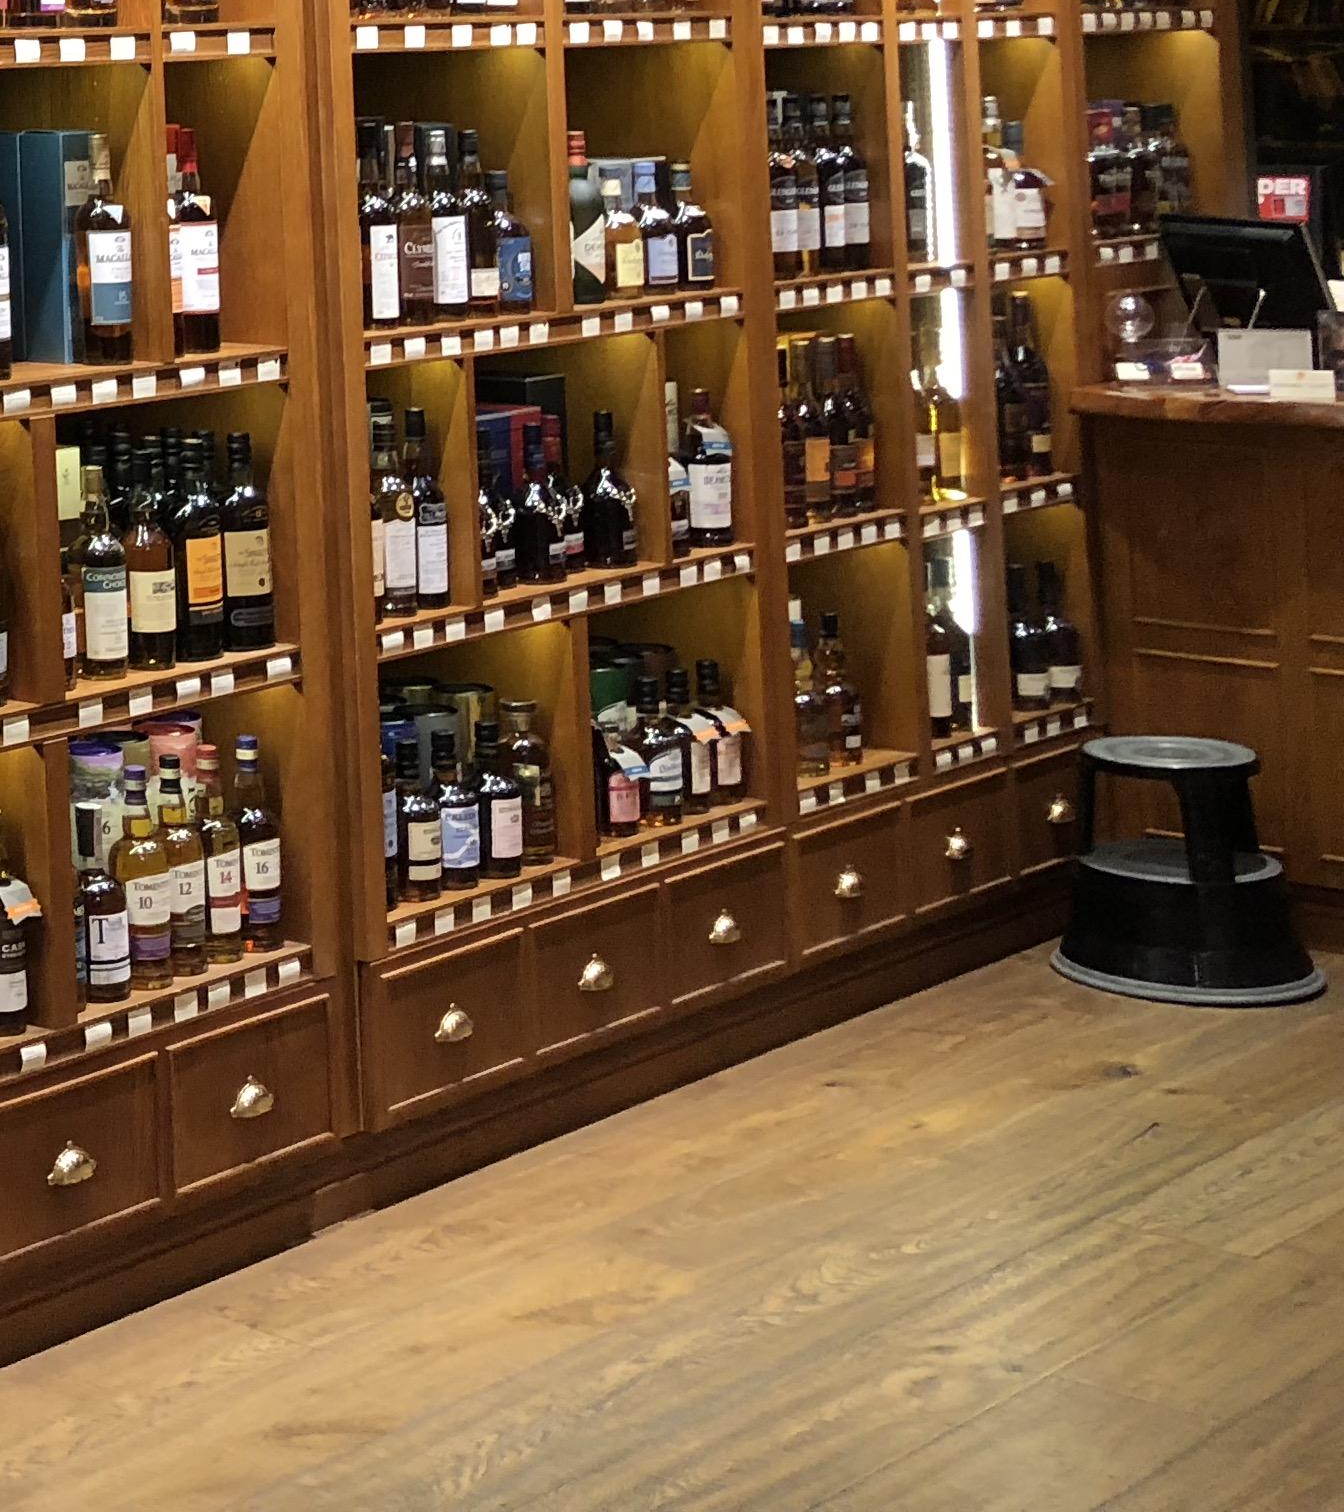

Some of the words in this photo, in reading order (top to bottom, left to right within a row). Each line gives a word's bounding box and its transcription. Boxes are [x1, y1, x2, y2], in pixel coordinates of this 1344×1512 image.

[255, 860, 270, 875] 16
[219, 871, 233, 885] 14
[178, 882, 193, 896] 12
[138, 895, 154, 910] 10
